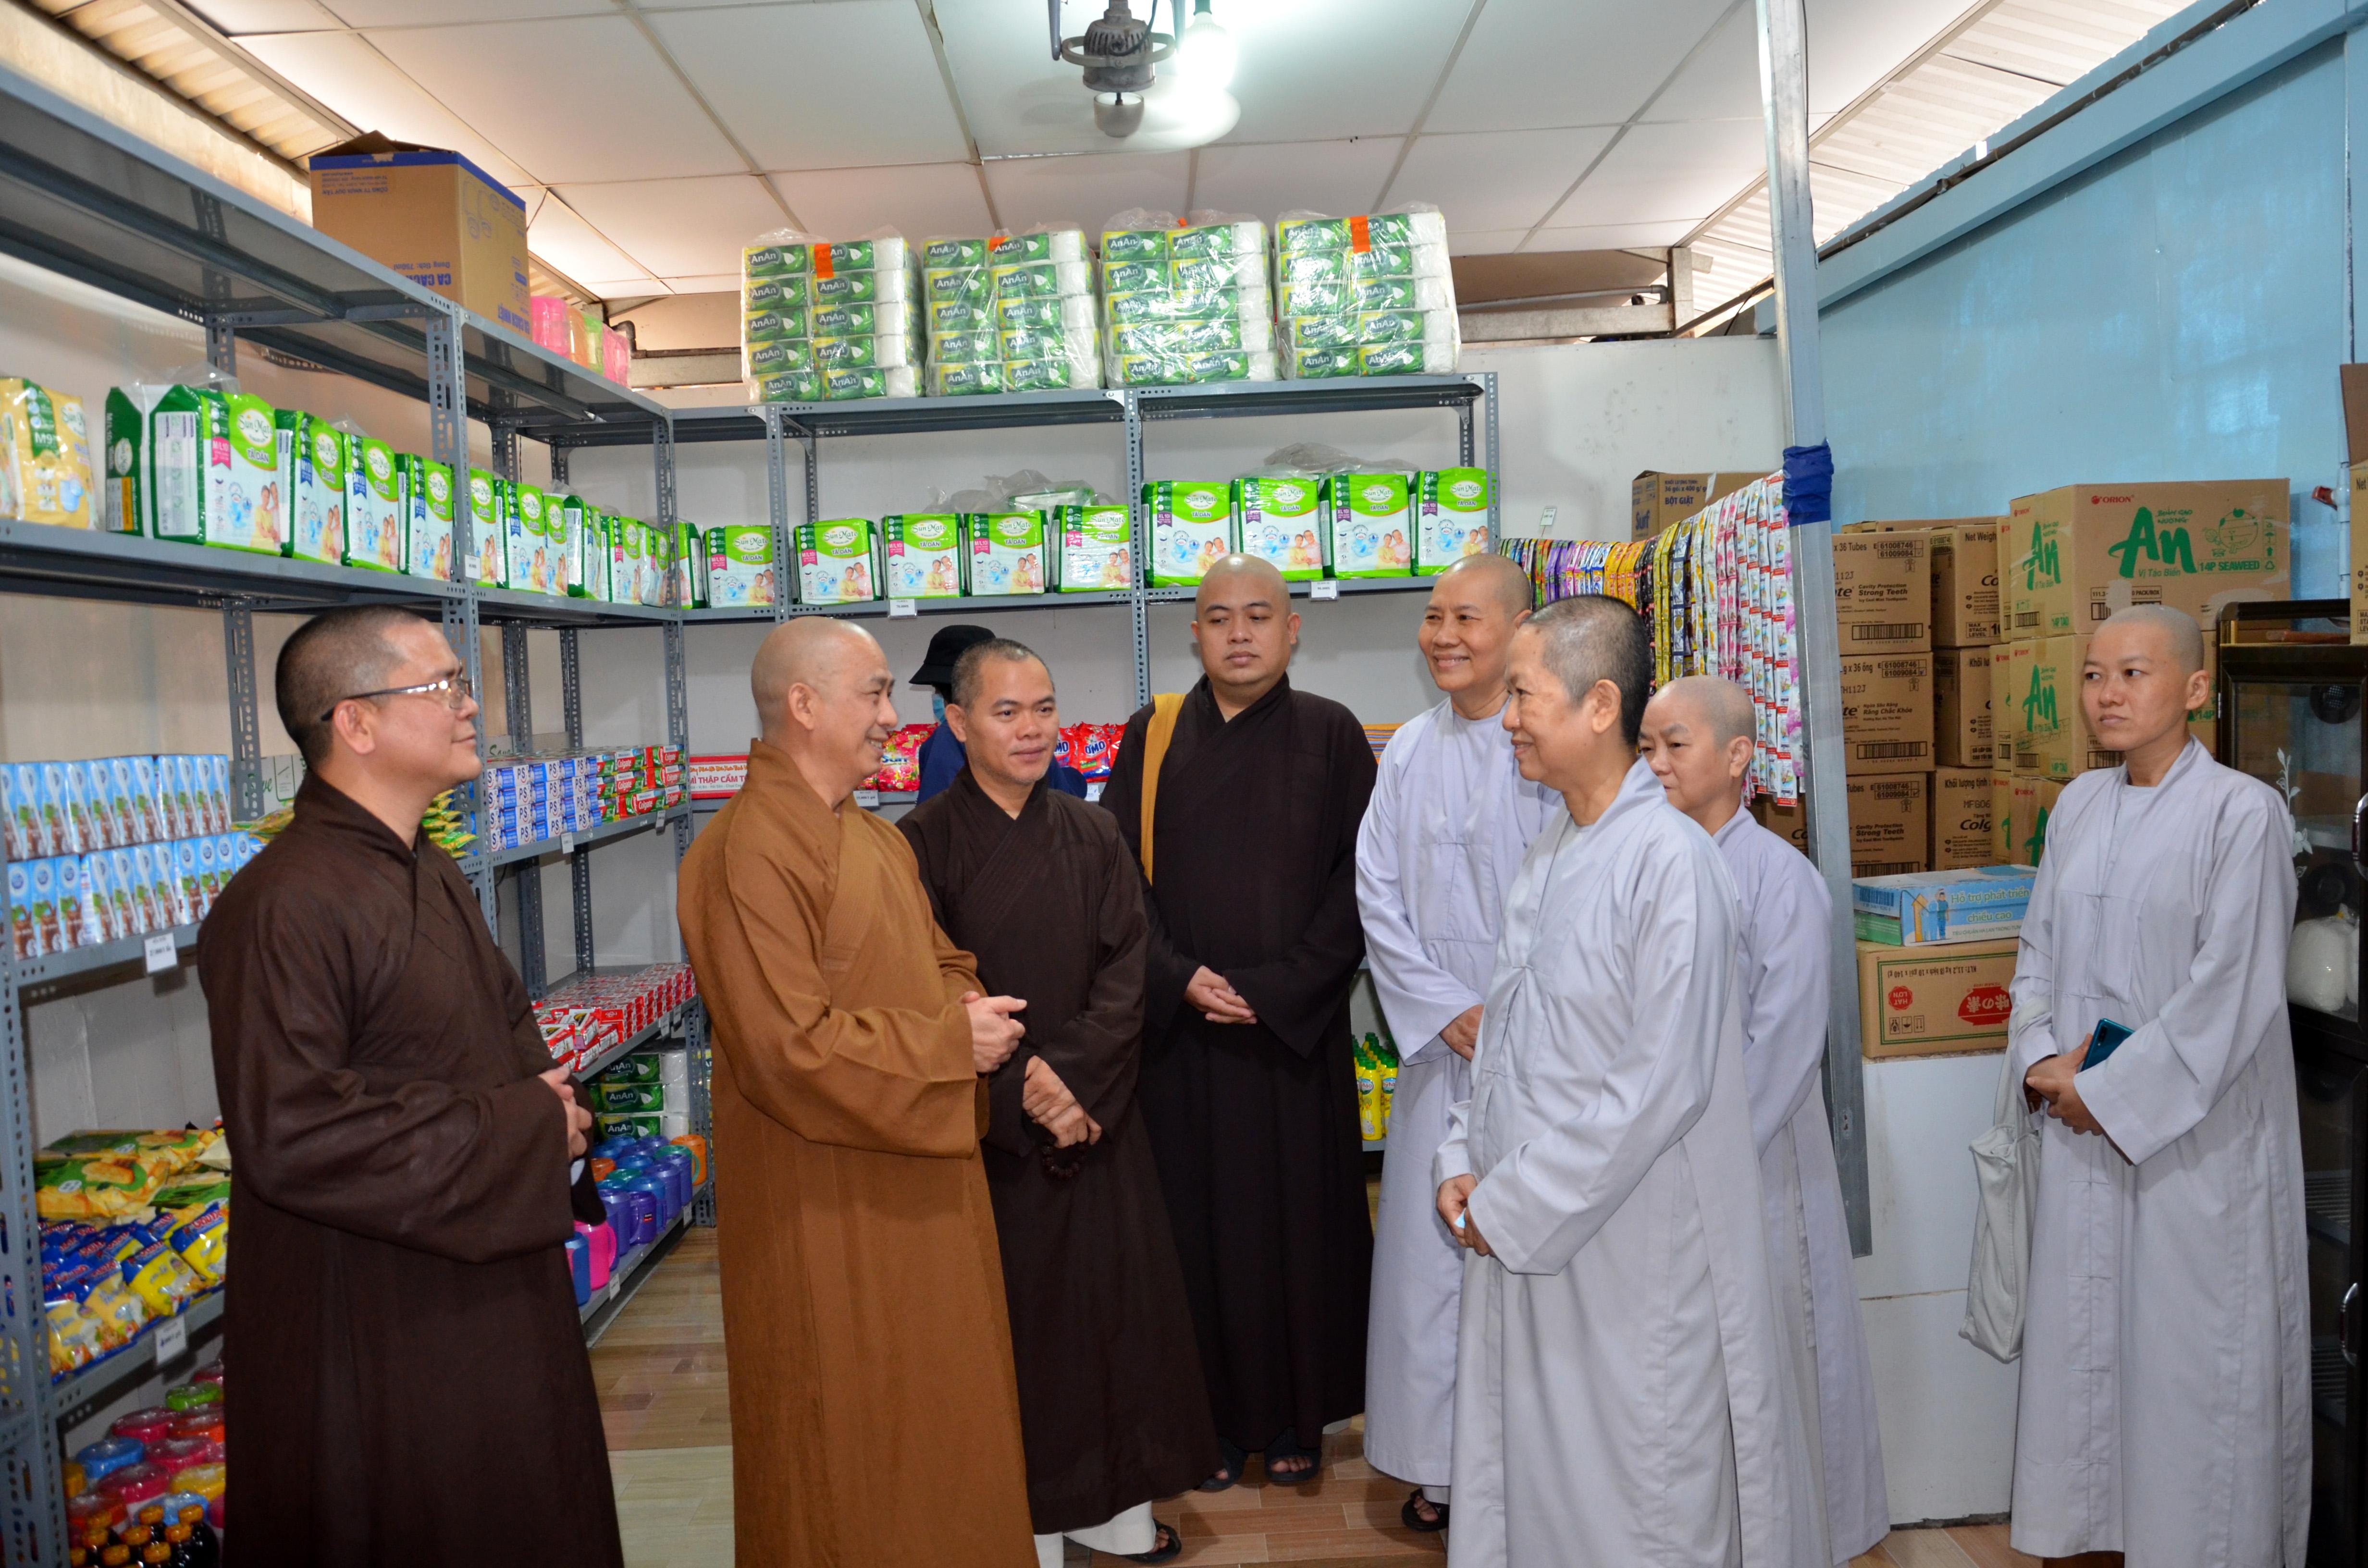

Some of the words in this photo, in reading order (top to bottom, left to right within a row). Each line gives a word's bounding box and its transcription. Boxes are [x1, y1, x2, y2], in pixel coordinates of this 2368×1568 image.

[1110, 238, 1137, 247] AnAn
[930, 246, 955, 255] AnAn
[995, 243, 1020, 253] AnAn
[751, 252, 776, 264] AnAn
[1112, 268, 1138, 279] AnAn
[937, 278, 962, 288] AnAn
[1001, 274, 1027, 284] AnAn
[819, 281, 845, 292] AnAn
[940, 307, 965, 317] AnAn
[1007, 306, 1033, 316] AnAn
[819, 312, 845, 323] AnAn
[751, 318, 776, 330] AnAn
[943, 339, 968, 349] AnAn
[755, 349, 780, 361] AnAn
[1305, 355, 1330, 366] AnAn
[1015, 367, 1041, 377] AnAn
[831, 376, 856, 388] AnAn
[1450, 485, 1465, 493] Sun
[2356, 478, 2367, 490] Net
[1363, 489, 1376, 498] Sun
[1184, 495, 1199, 504] Sun
[1665, 496, 1677, 506] BỘT
[912, 525, 926, 533] Sun
[997, 522, 1012, 530] Sun
[824, 532, 838, 541] Sun
[1965, 532, 1976, 542] Net
[733, 537, 748, 547] Sun
[1839, 543, 1847, 551] 36
[1849, 542, 1867, 551] Tubes
[2108, 506, 2197, 578] An
[2022, 521, 2061, 591] An
[2199, 561, 2216, 571] 14P
[2218, 560, 2260, 571] SEAWEED
[1854, 663, 1861, 672] 36
[1969, 658, 1982, 667] Khối
[2022, 664, 2059, 733] An
[1054, 740, 1070, 754] MO
[1085, 740, 1106, 755] OMO
[617, 759, 632, 769] Colgate
[618, 780, 632, 790] Colgate
[1945, 778, 1958, 788] Khối
[1959, 778, 1974, 789] lượng
[1976, 777, 1987, 788] tịnh
[638, 800, 654, 810] Colgate
[1951, 890, 1966, 903] Hỗ
[1968, 892, 1982, 903] trợ
[1984, 888, 2006, 903] phát
[2008, 886, 2030, 898] triển
[1967, 910, 1993, 923] chiều
[1995, 911, 2012, 921] cao
[1894, 970, 1903, 979] 140
[609, 1091, 633, 1101] AnAn
